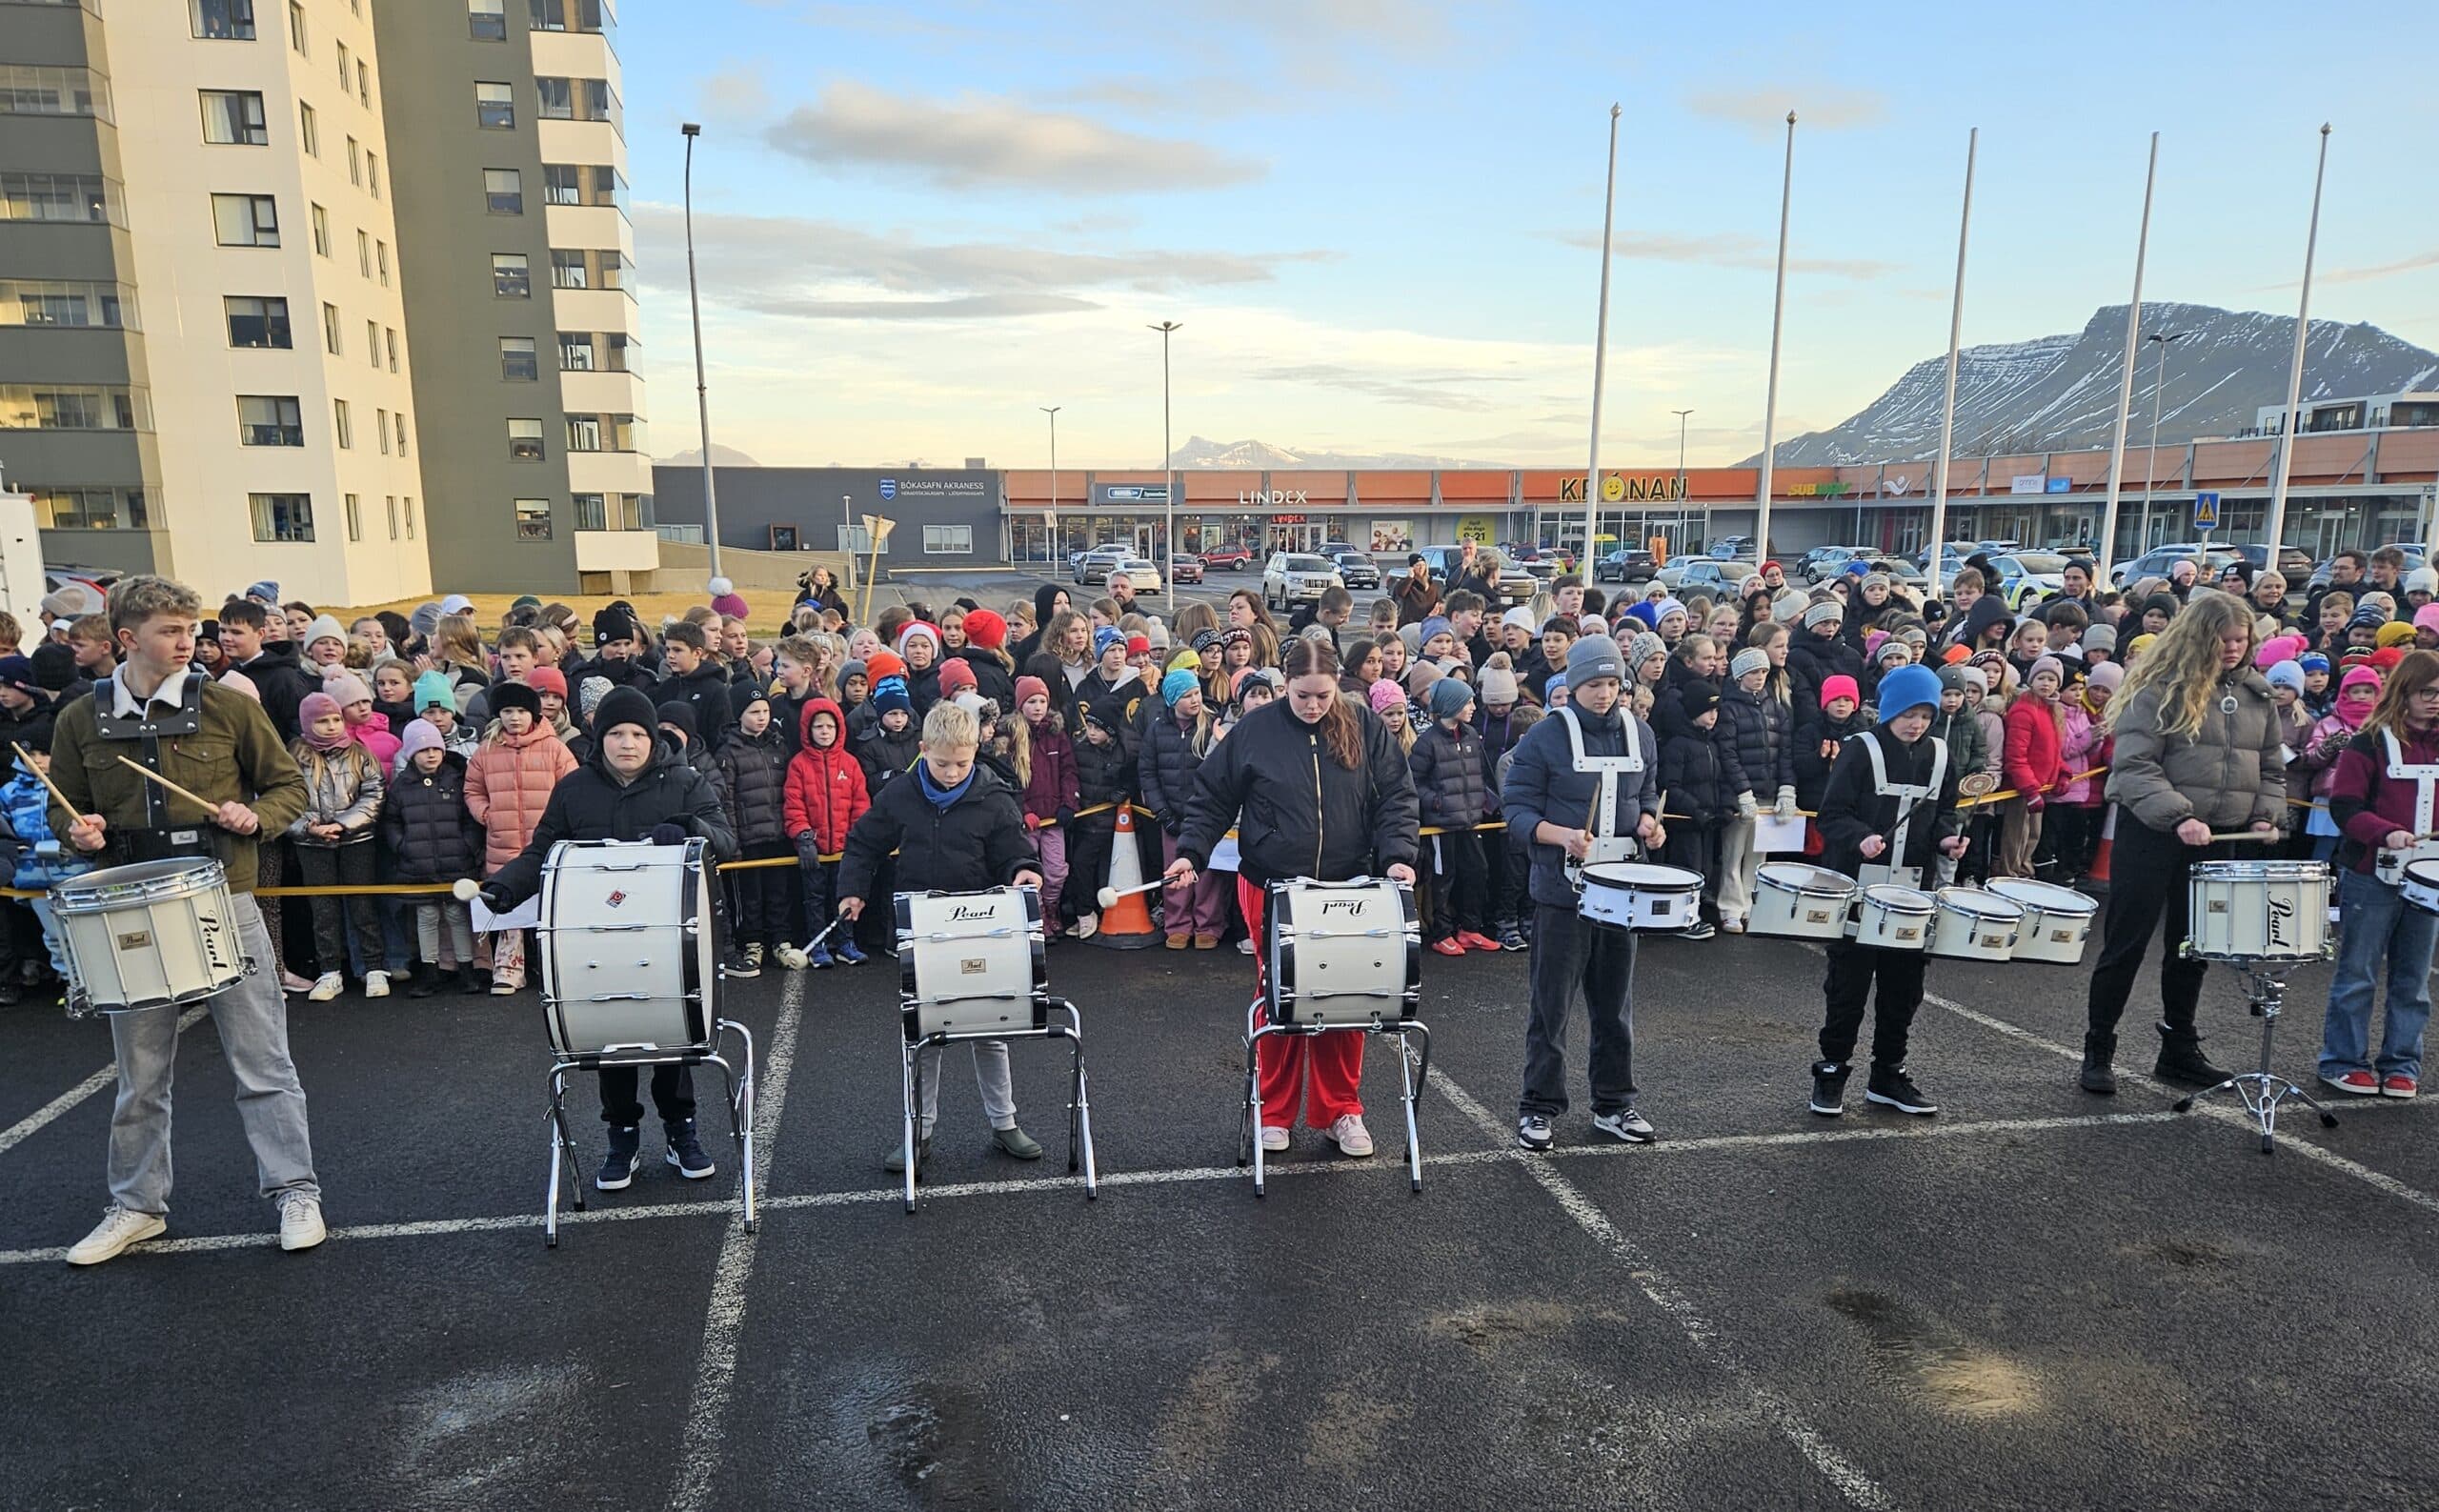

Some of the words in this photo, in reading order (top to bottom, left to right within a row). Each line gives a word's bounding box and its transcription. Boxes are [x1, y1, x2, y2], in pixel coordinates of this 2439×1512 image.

[900, 480, 942, 490] BÓKASAFN
[943, 481, 984, 490] AKRANESS
[1240, 490, 1308, 504] LINDEX
[944, 904, 997, 921] Pearl
[1321, 898, 1372, 917] Pearl
[2268, 891, 2294, 948] Pearl
[198, 909, 229, 969] Pearl
